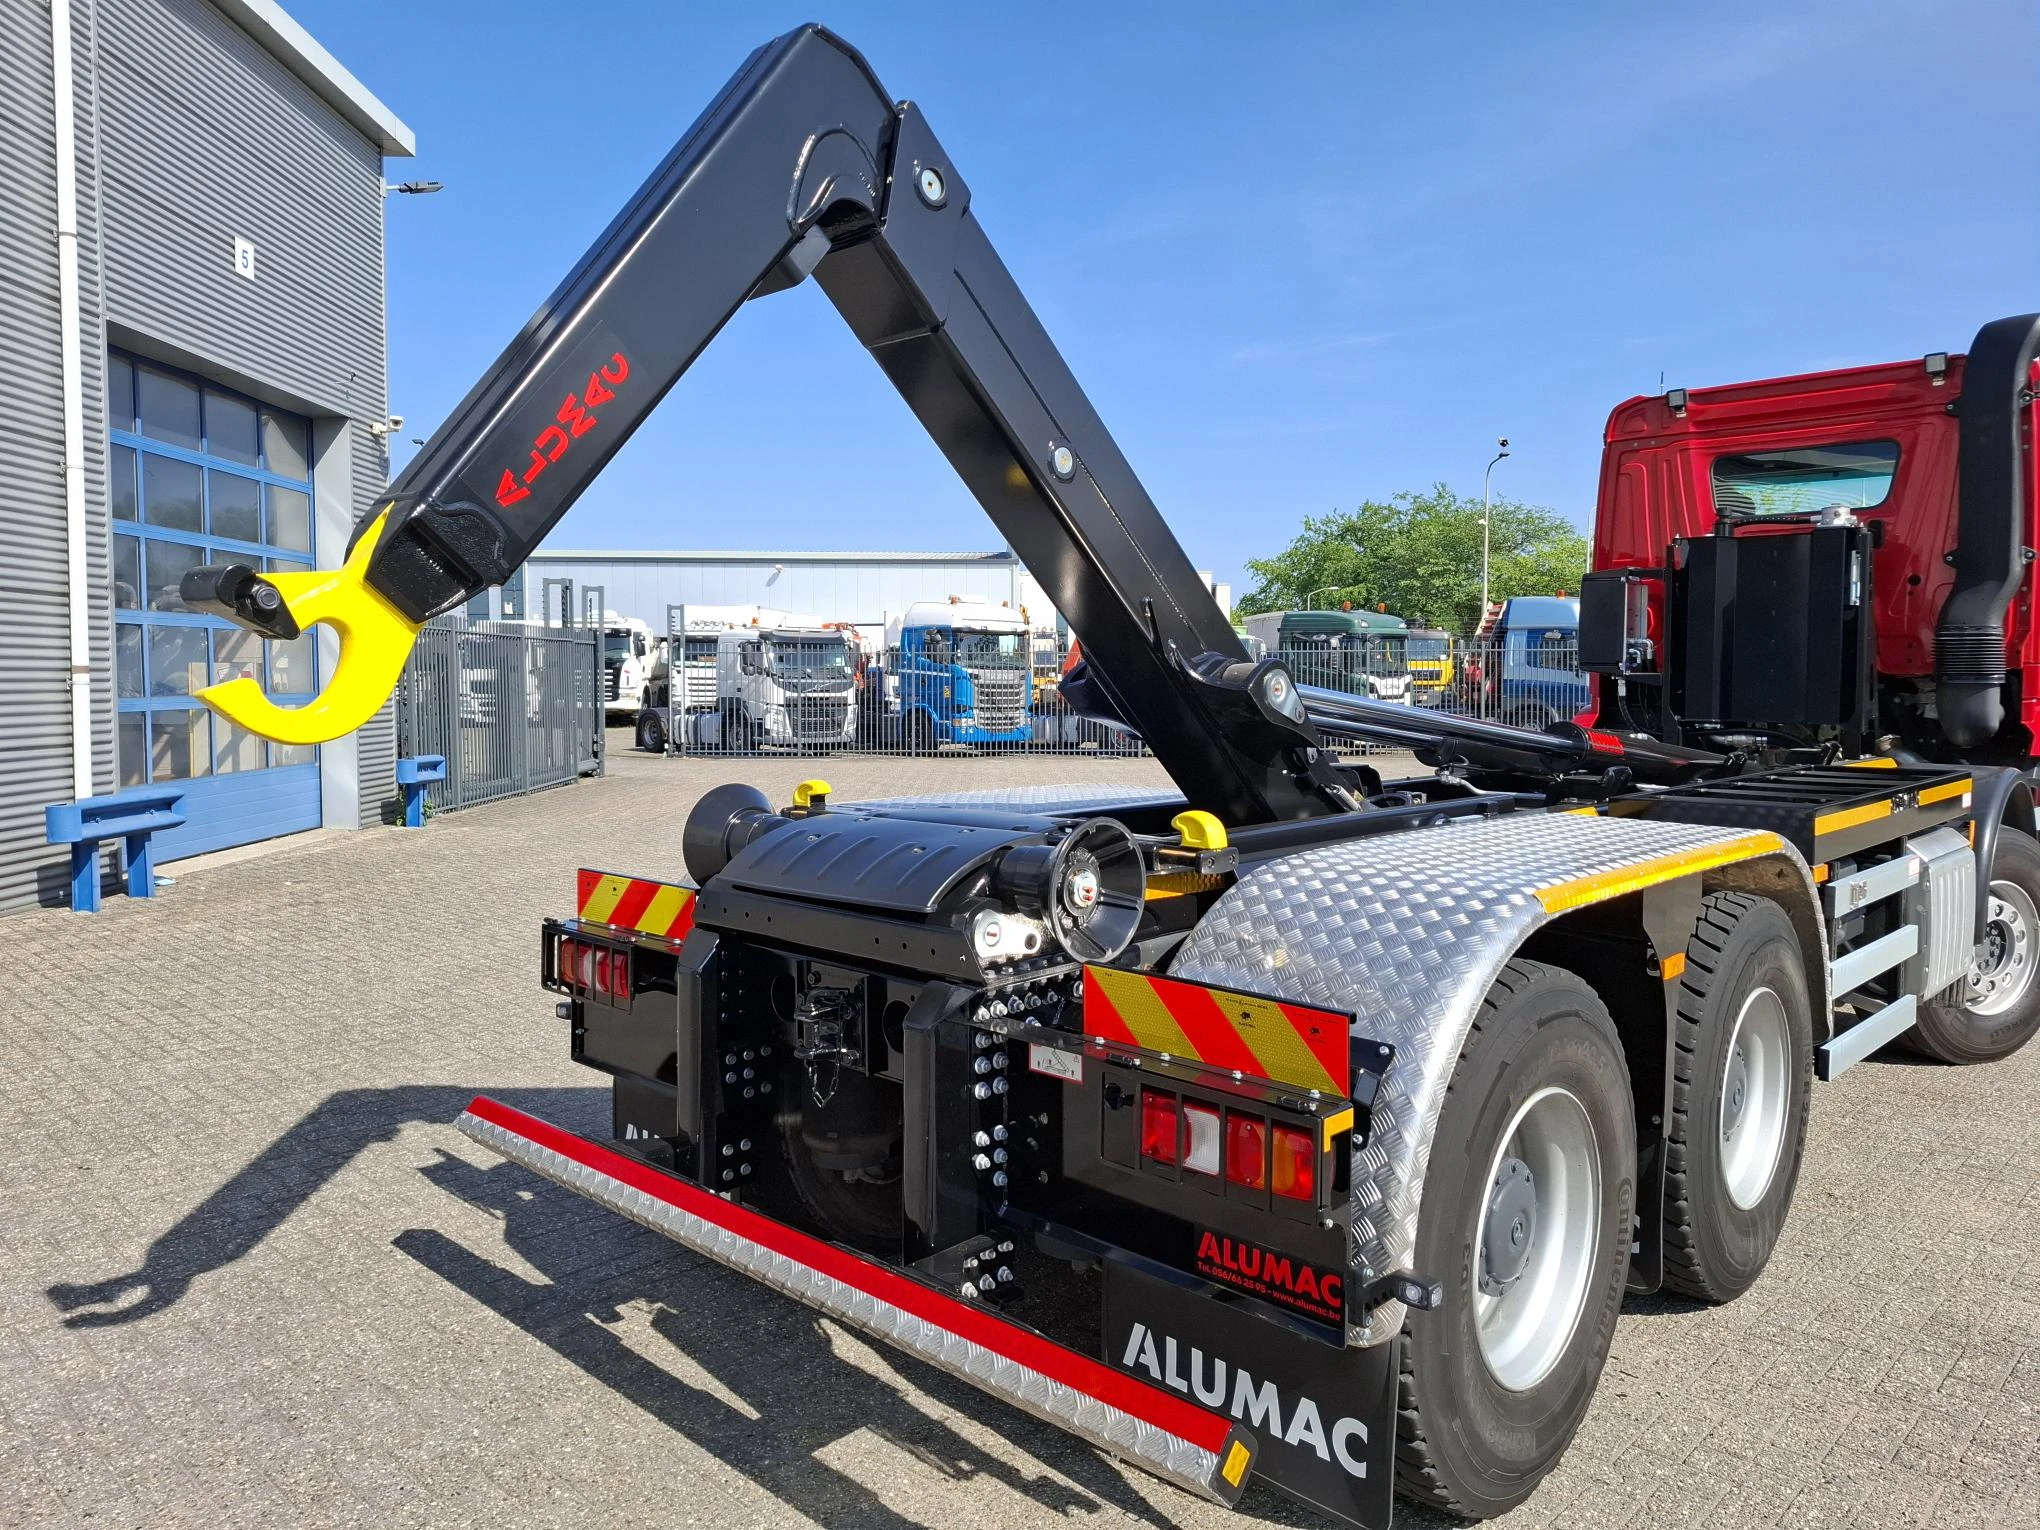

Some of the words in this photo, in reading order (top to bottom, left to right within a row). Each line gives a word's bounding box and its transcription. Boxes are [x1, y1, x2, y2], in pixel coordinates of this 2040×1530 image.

[242, 249, 248, 269] 5
[496, 352, 629, 508] ALUMAC
[1197, 1231, 1341, 1308] ALUMAC
[1272, 1289, 1341, 1320] www.alumac.be
[1122, 1322, 1368, 1479] ALUMAC
